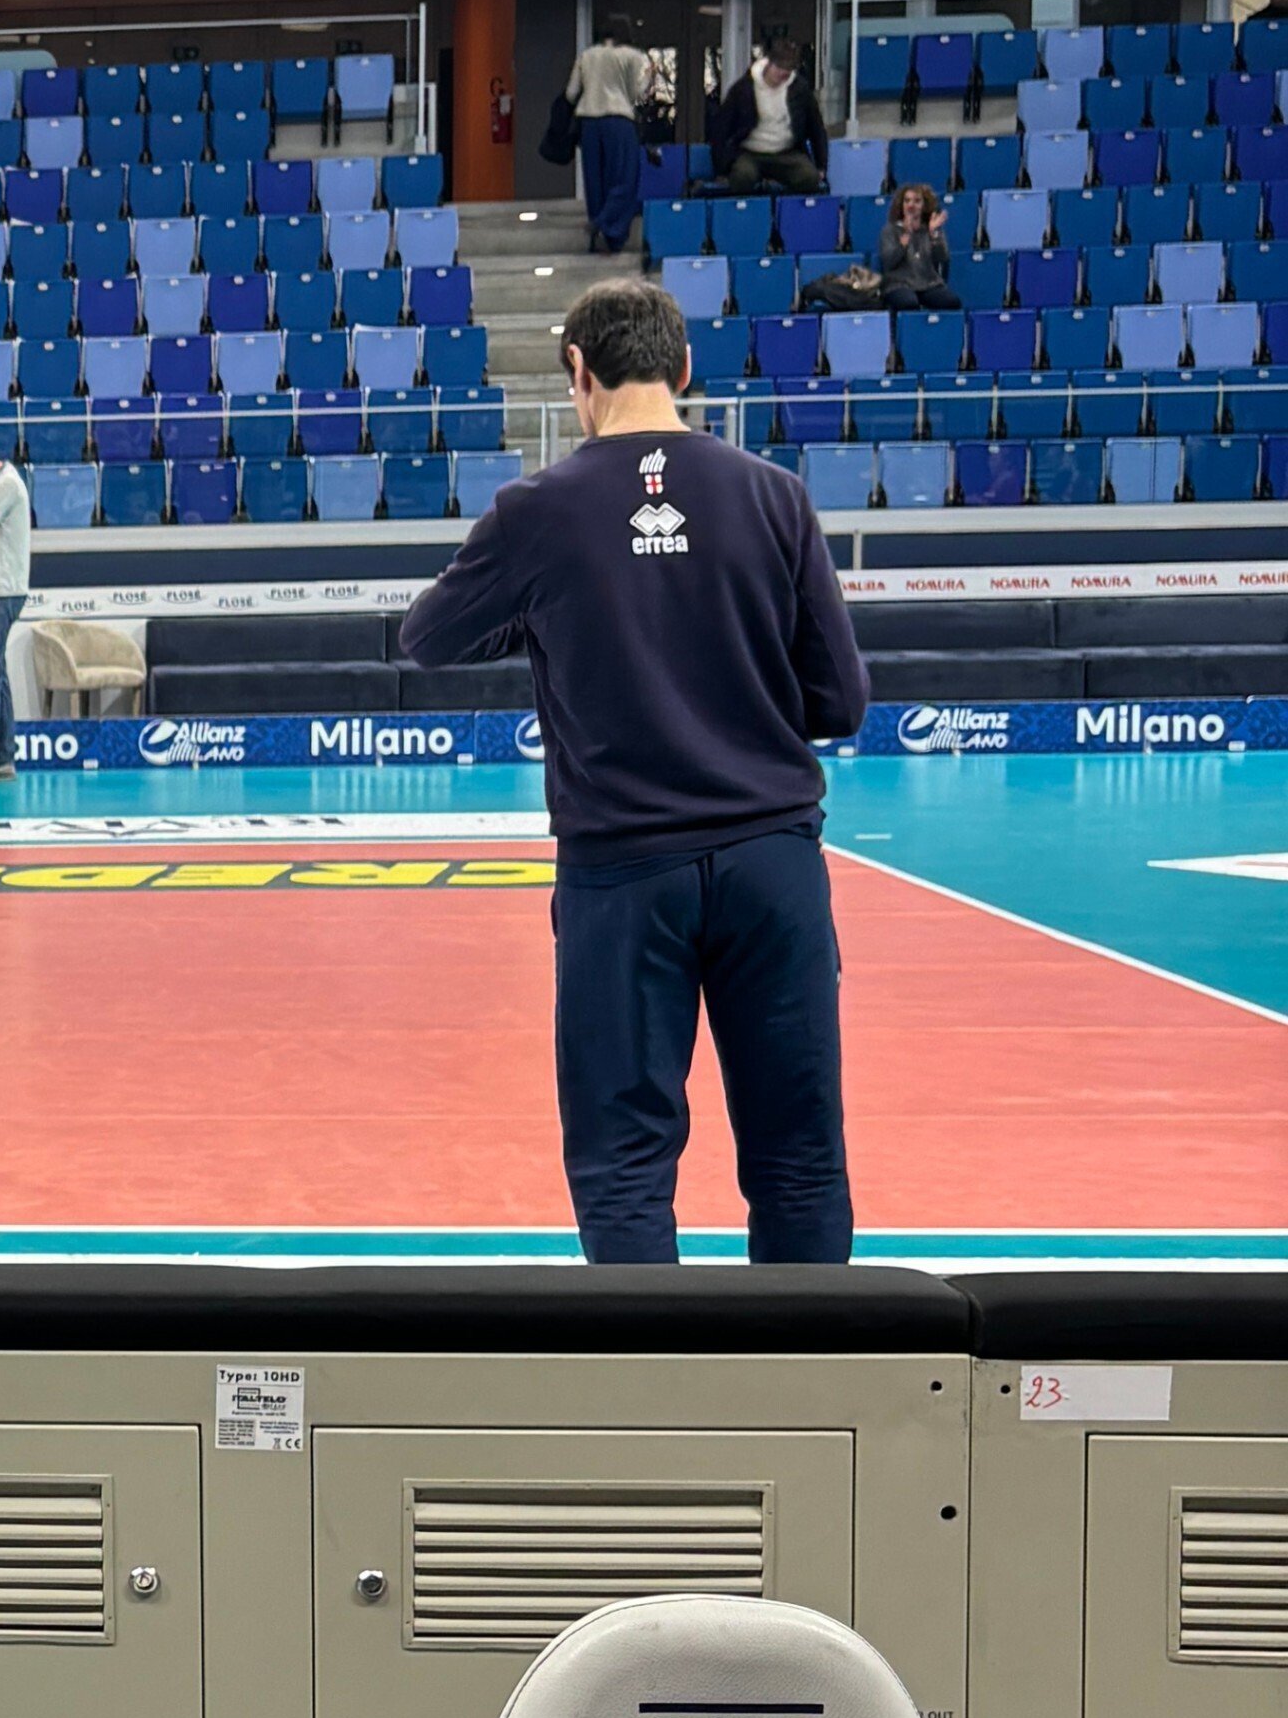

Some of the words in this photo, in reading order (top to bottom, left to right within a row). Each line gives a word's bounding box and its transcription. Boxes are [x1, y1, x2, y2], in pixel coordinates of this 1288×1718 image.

[906, 578, 966, 592] NOMURA
[990, 577, 1051, 591] NOMURA
[1071, 575, 1132, 589] NOMURA
[1156, 573, 1218, 588] NOMURA
[935, 706, 1010, 731] Allianz
[1076, 704, 1225, 745] Milano
[175, 722, 246, 743] Allianz
[310, 718, 453, 757] Milano
[219, 1370, 258, 1383] Type:
[263, 1371, 300, 1382] 10HD
